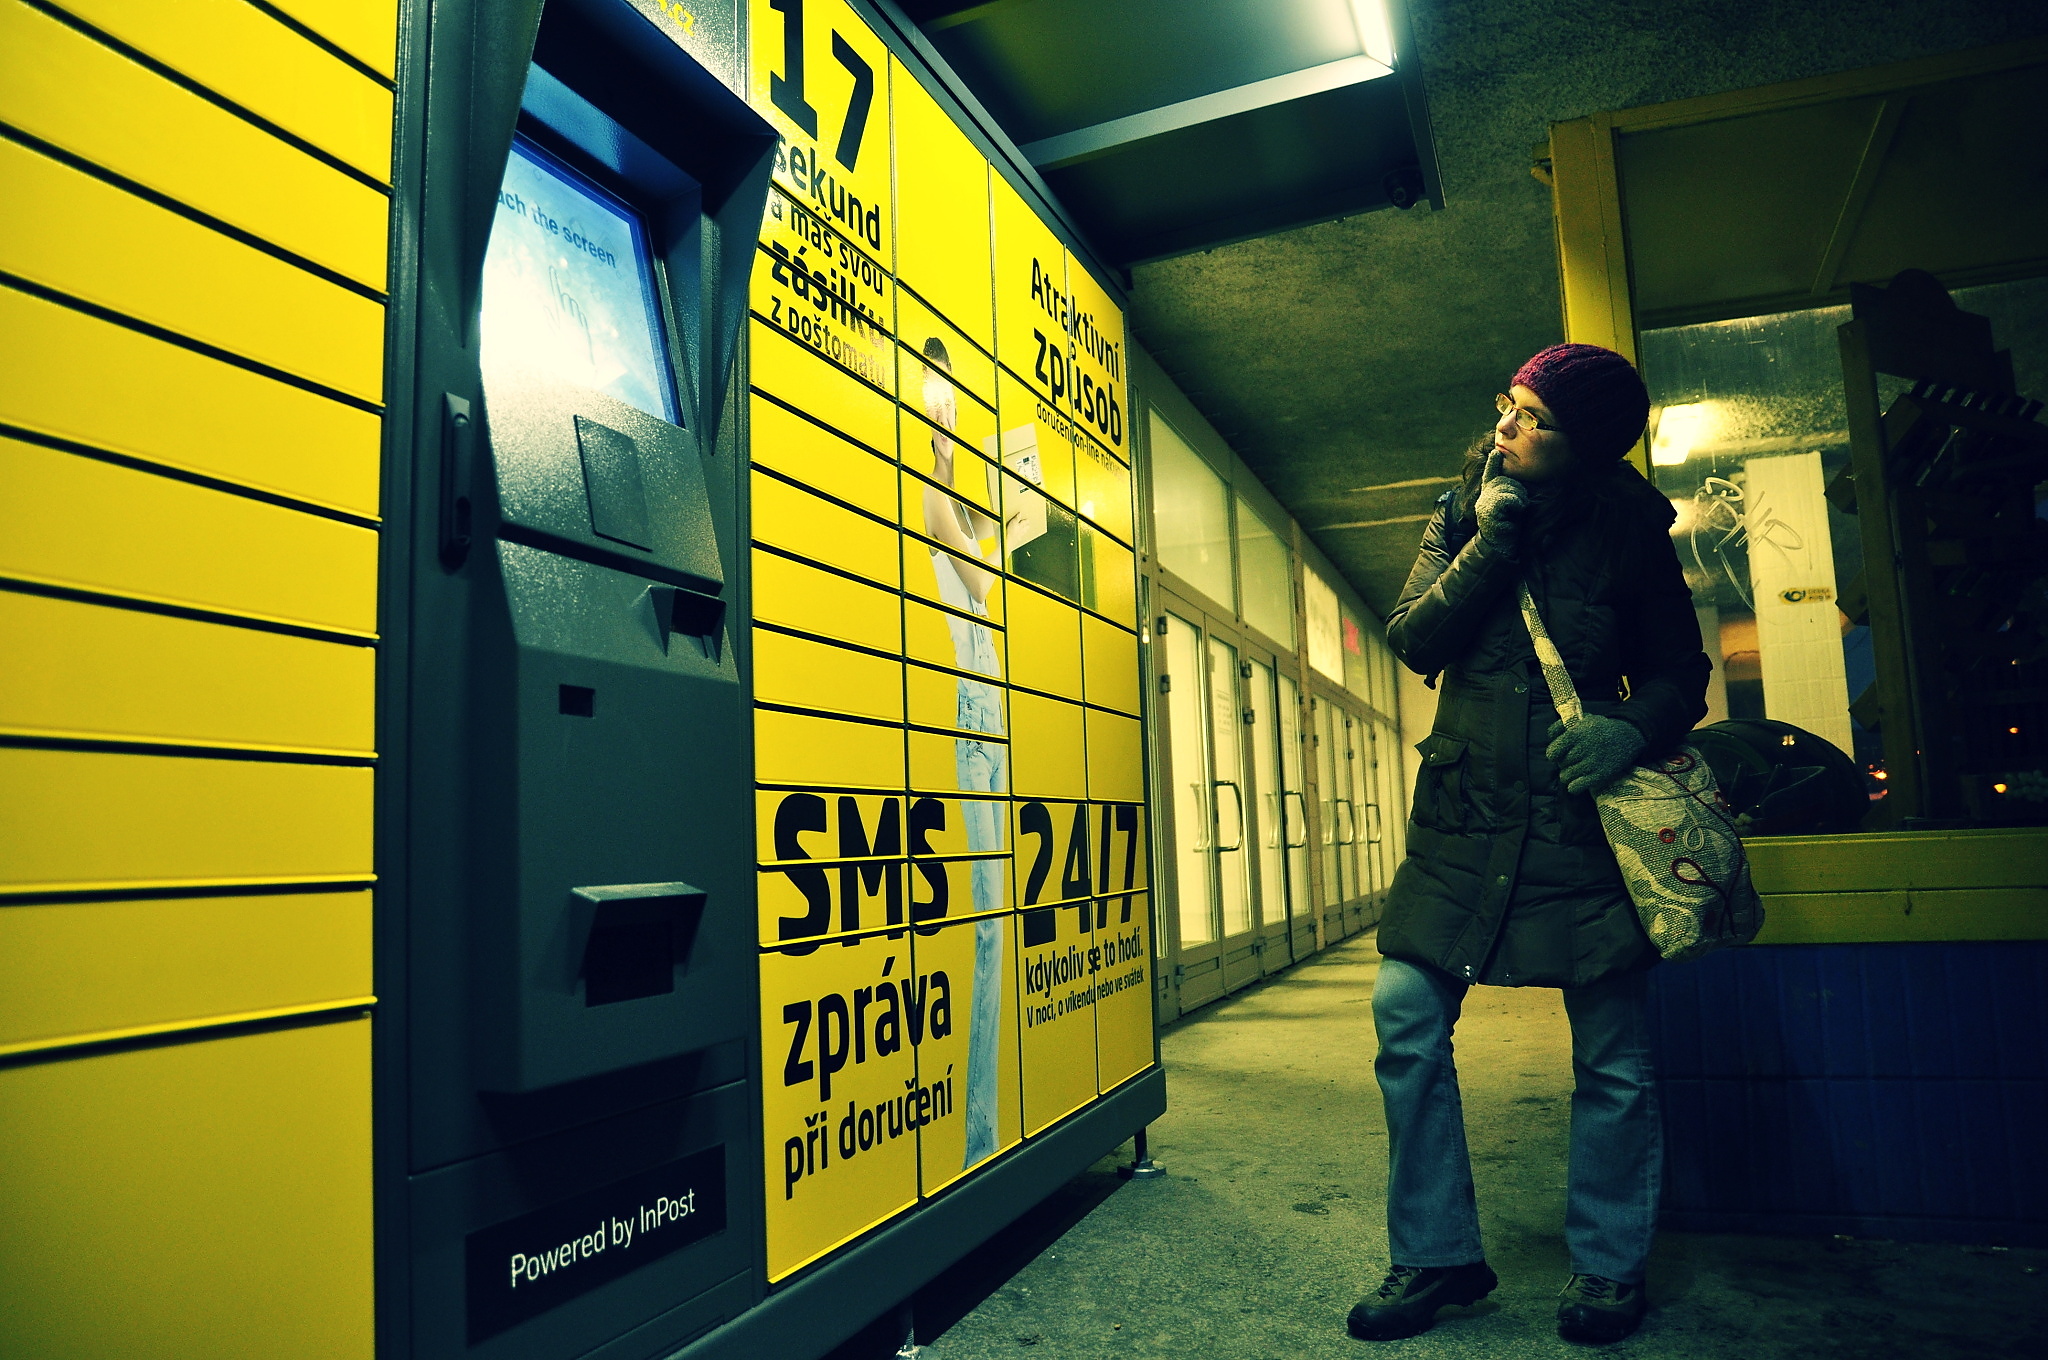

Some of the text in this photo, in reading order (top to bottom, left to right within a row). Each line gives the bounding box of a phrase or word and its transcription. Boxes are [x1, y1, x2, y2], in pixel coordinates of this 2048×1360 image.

[770, 0, 874, 174] 17
[532, 206, 559, 236] the
[562, 225, 617, 269] screen
[774, 132, 881, 251] sekund
[771, 239, 886, 352] zásilku
[790, 204, 833, 258] máš
[839, 242, 884, 297] svou
[771, 295, 782, 325] z
[1031, 257, 1120, 383] Atraktivní
[1033, 327, 1122, 447] způsob
[1036, 398, 1074, 444] doručení
[774, 793, 949, 957] SMS
[1019, 803, 1138, 949] 24/7
[1025, 926, 1144, 999] kdykoliv se to hodí.
[1026, 965, 1145, 1028] V noci, o víkendu nebo ve svátek
[783, 956, 952, 1102] zpráva
[784, 1063, 954, 1201] při doručení
[510, 1188, 696, 1289] Powered by InPost
